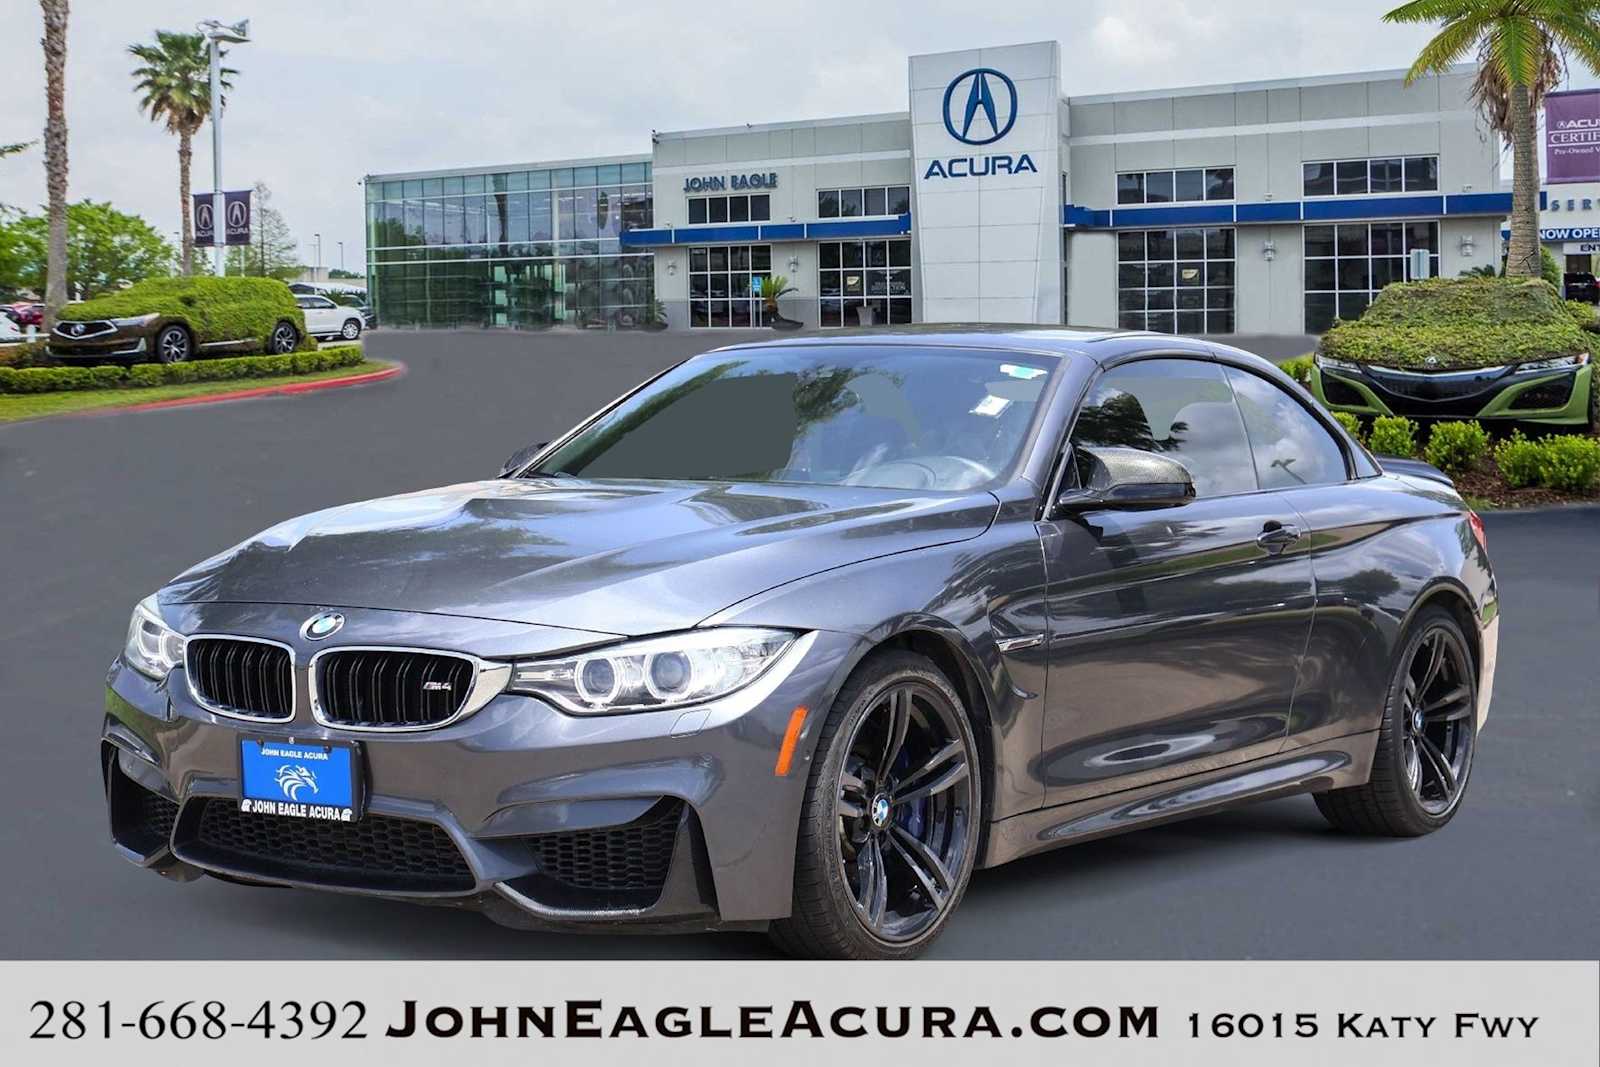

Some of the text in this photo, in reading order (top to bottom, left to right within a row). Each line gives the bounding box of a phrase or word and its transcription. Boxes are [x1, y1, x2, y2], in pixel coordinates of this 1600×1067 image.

[924, 154, 1037, 179] ACURA
[683, 173, 777, 193] JOHN EAGLE
[1572, 228, 1600, 239] OPE
[423, 681, 452, 691] M4
[261, 747, 329, 760] JOHN EAGLE ACURA
[252, 800, 341, 820] JOHN EAGLE ACURA
